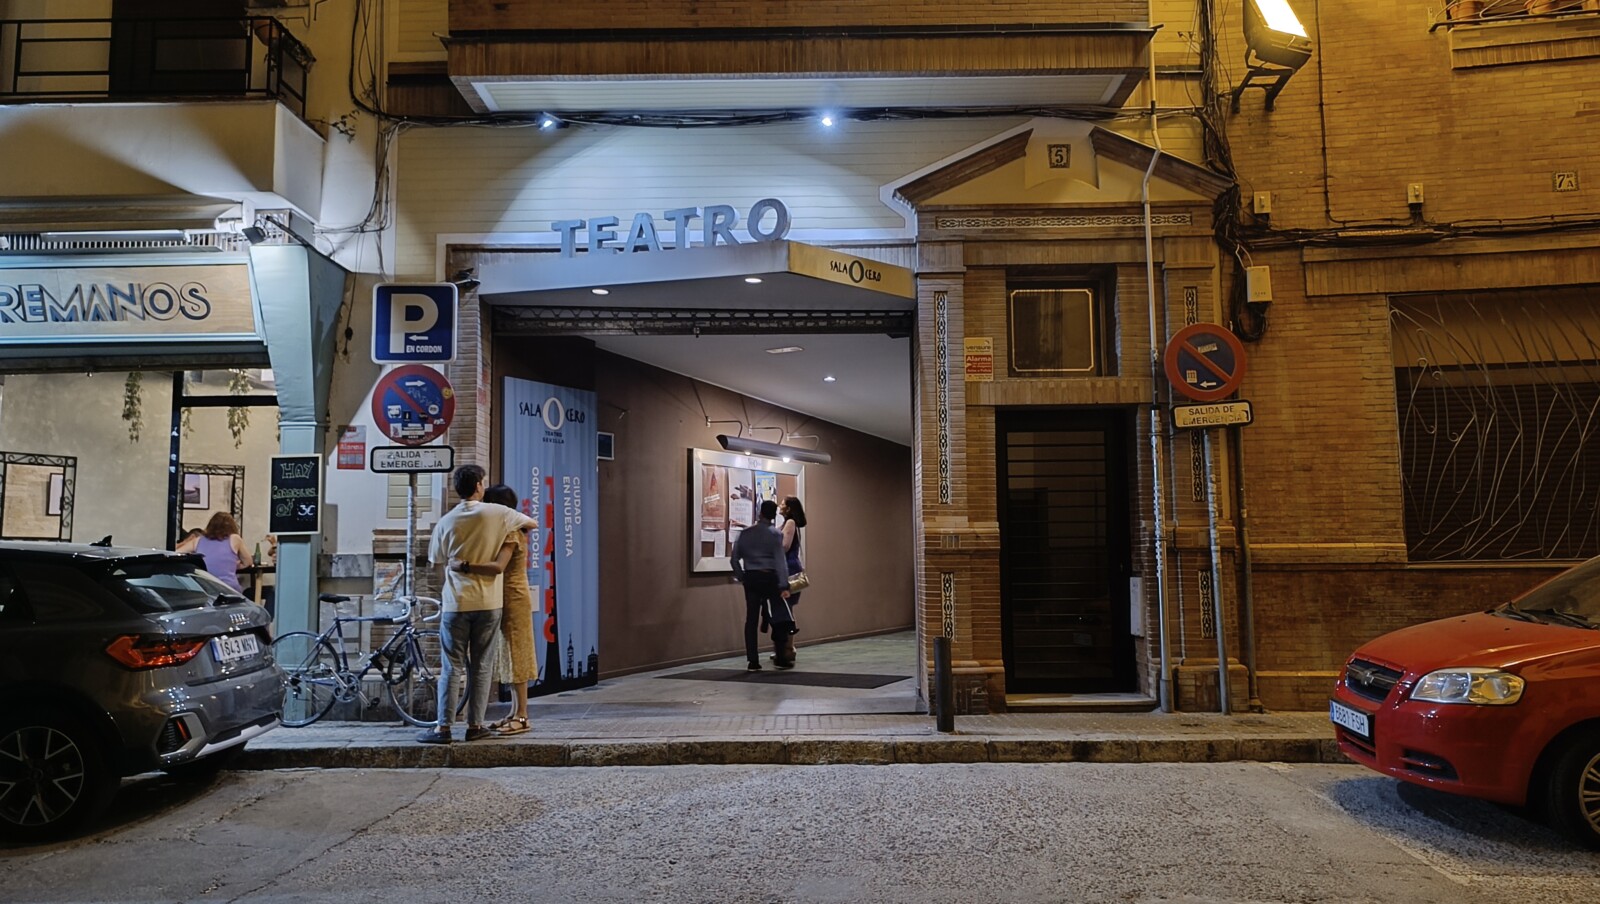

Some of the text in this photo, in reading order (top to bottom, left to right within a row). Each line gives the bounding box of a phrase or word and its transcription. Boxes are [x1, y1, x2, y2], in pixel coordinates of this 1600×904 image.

[1054, 149, 1064, 164] 5
[551, 198, 791, 258] TEATRO
[830, 260, 848, 274] SALA
[865, 269, 882, 282] CERO
[389, 293, 439, 354] P
[406, 345, 442, 353] EN CORDON
[519, 402, 542, 418] SALA
[565, 408, 586, 423] CERO
[1188, 405, 1235, 415] SALIDA DE
[545, 430, 563, 438] TEATRO
[280, 461, 315, 479] HAY
[380, 460, 443, 468] EMERGEIA
[572, 476, 582, 525] CIUDAD
[562, 476, 574, 558] EN NUESTRA
